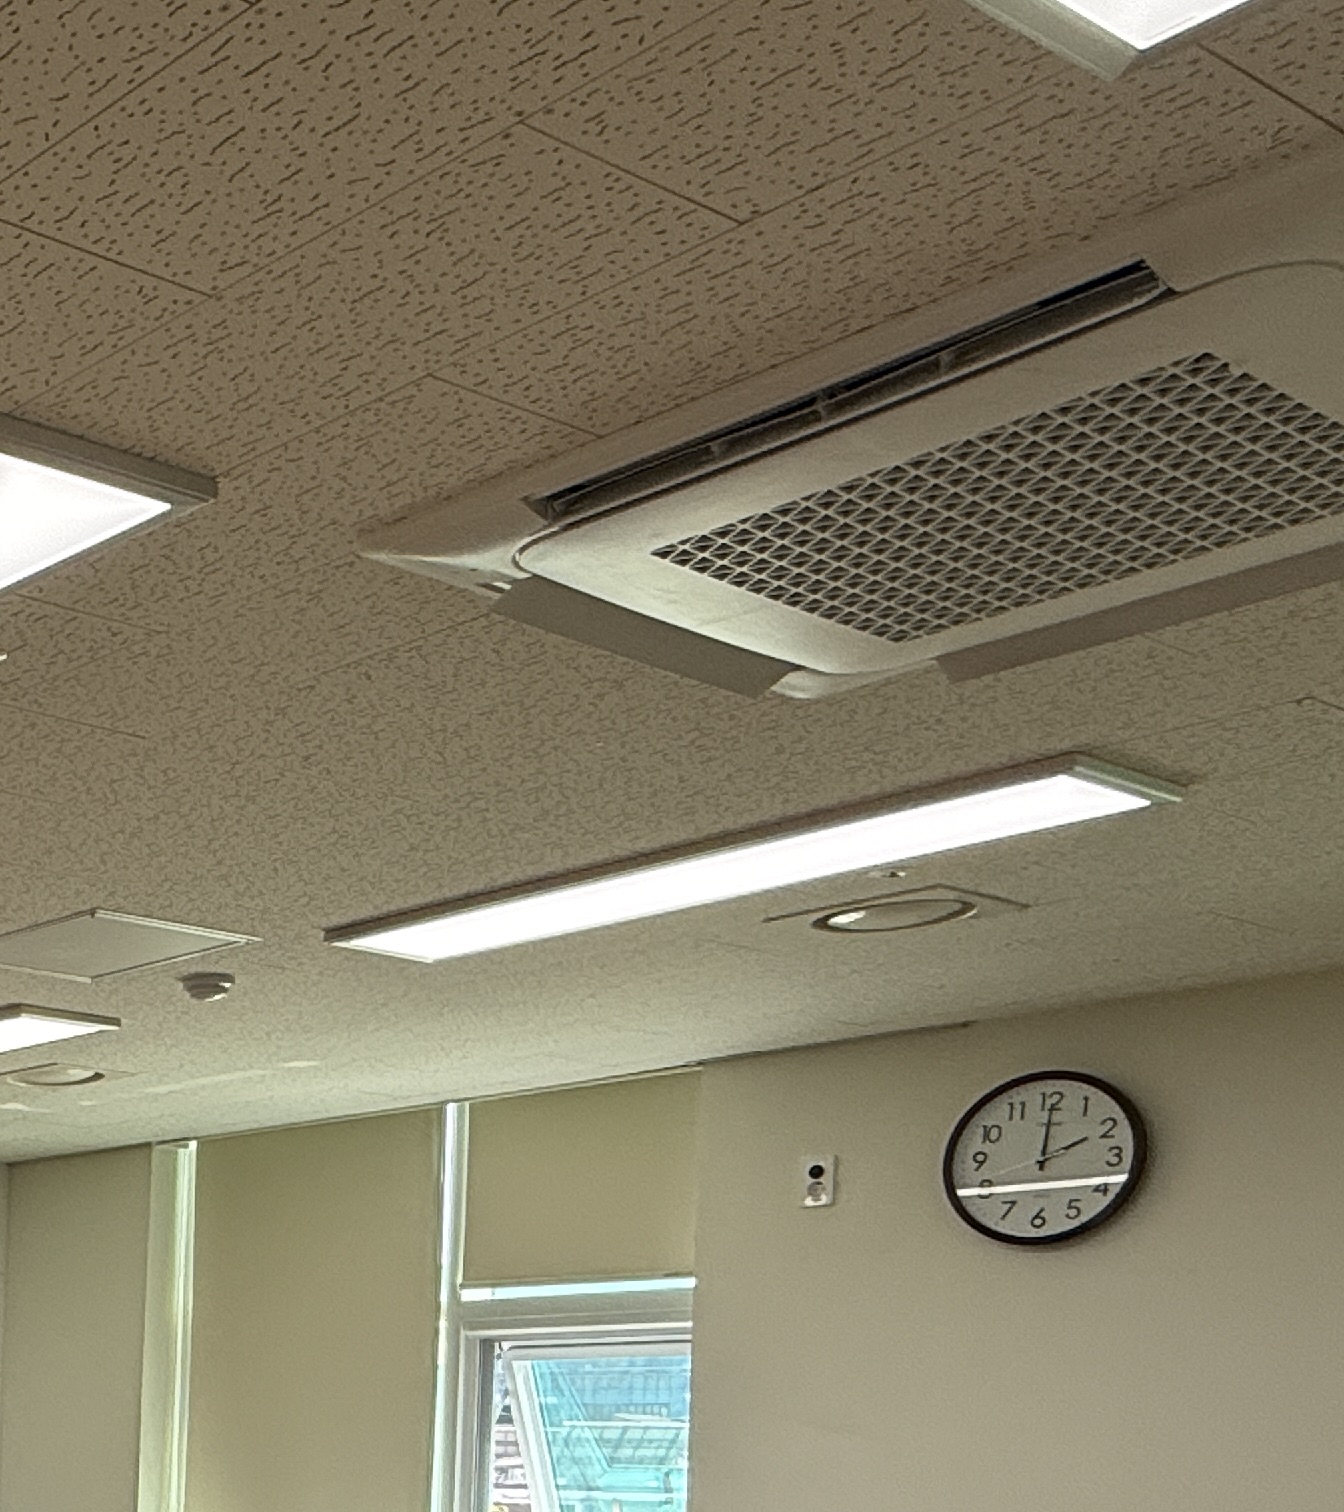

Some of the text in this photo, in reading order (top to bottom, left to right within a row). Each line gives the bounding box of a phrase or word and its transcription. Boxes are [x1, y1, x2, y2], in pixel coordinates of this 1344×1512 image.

[1007, 1101, 1025, 1121] 11
[1040, 1091, 1064, 1112] 12
[1082, 1096, 1090, 1117] 1
[981, 1124, 1002, 1144] 10
[1099, 1117, 1118, 1139] 2
[972, 1151, 988, 1171] 9
[1105, 1146, 1123, 1167] 3
[1001, 1201, 1017, 1220] 7
[1030, 1207, 1046, 1229] 6
[1065, 1199, 1081, 1219] 5
